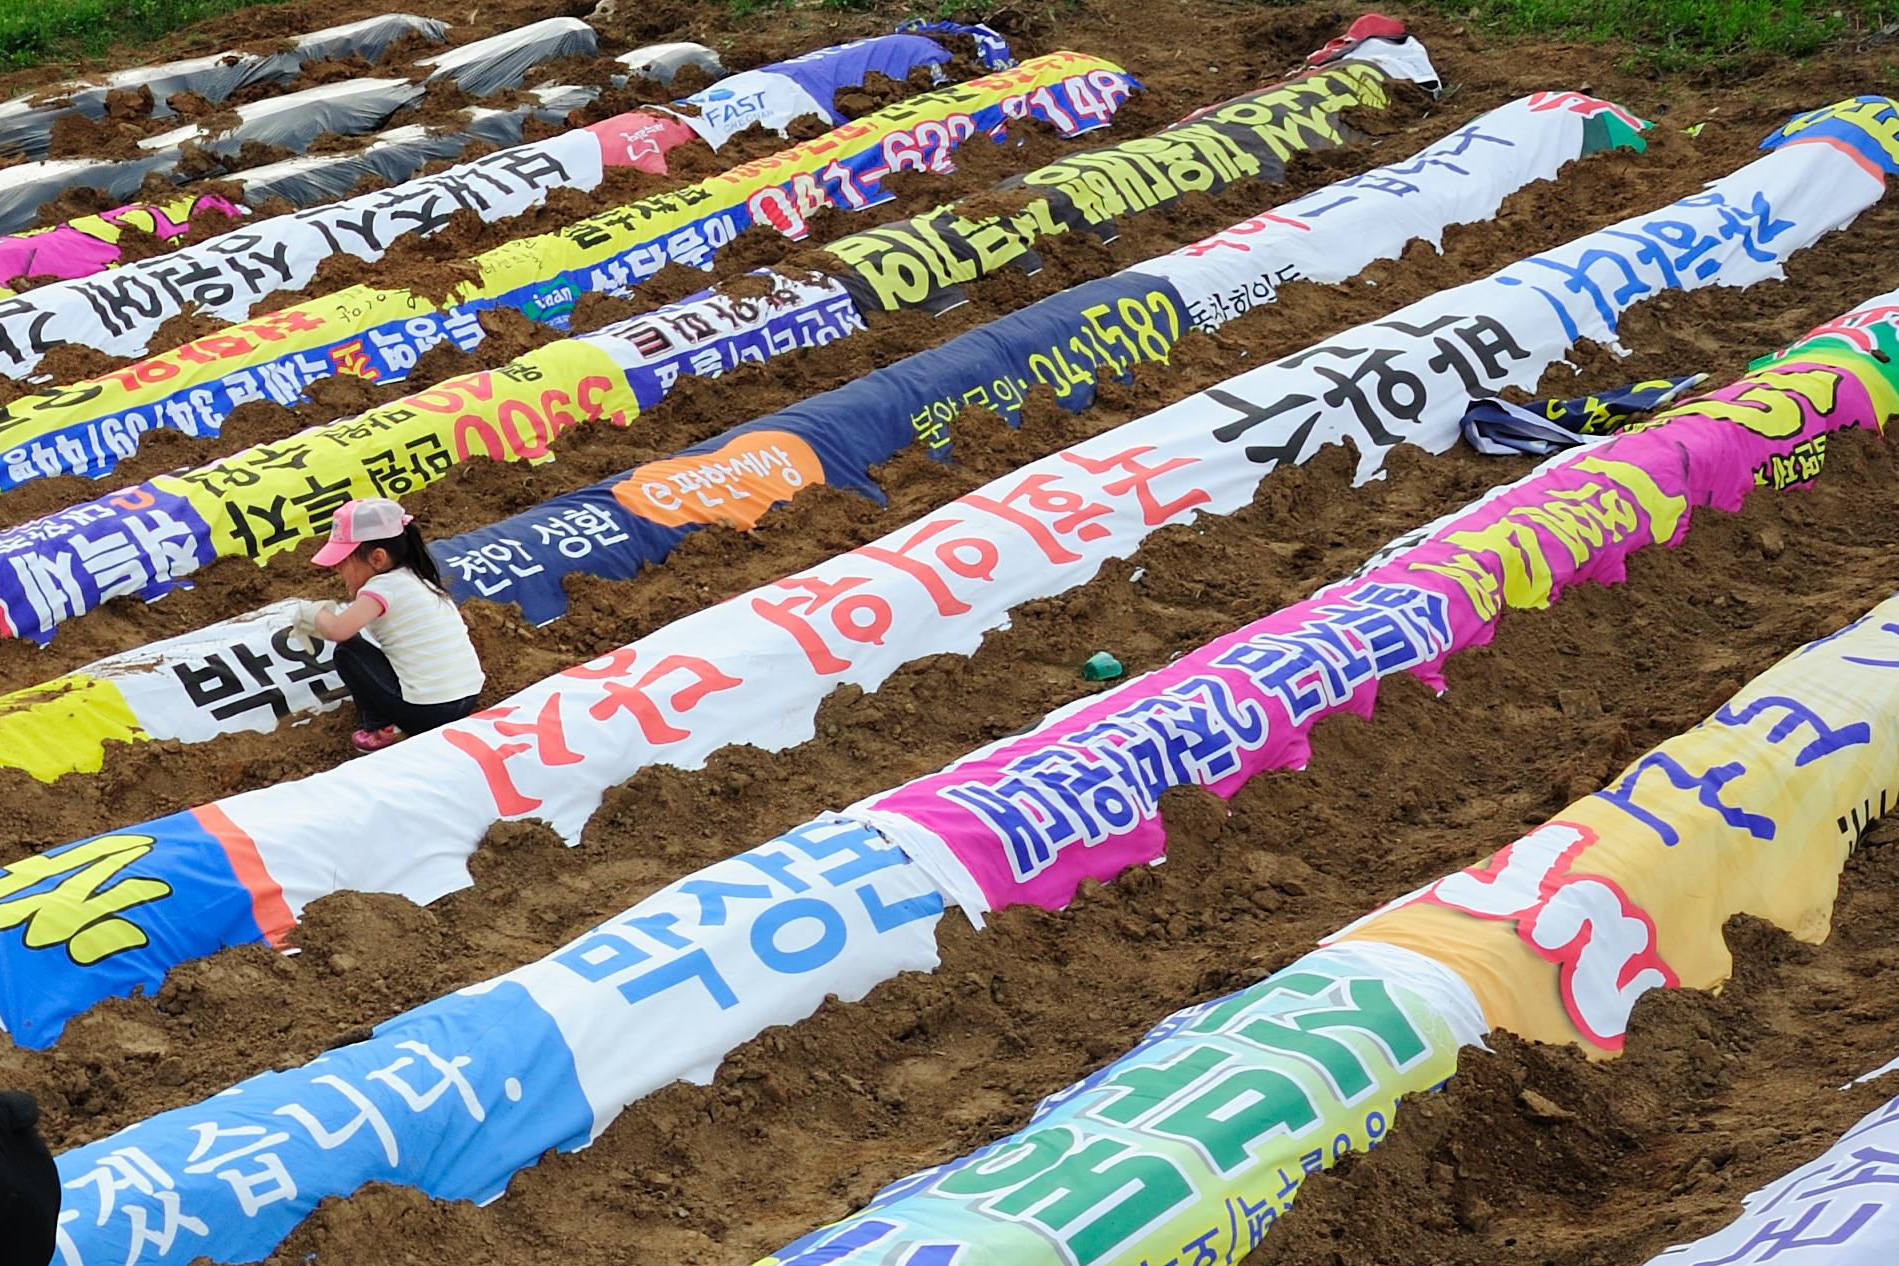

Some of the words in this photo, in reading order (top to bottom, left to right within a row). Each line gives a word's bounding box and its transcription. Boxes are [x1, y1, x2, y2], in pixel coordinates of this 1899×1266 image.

[705, 90, 767, 128] FAST
[1206, 313, 1532, 468] 박완수
[448, 534, 544, 598] 천안
[531, 502, 630, 559] 성환
[751, 446, 1212, 675] 국회의원
